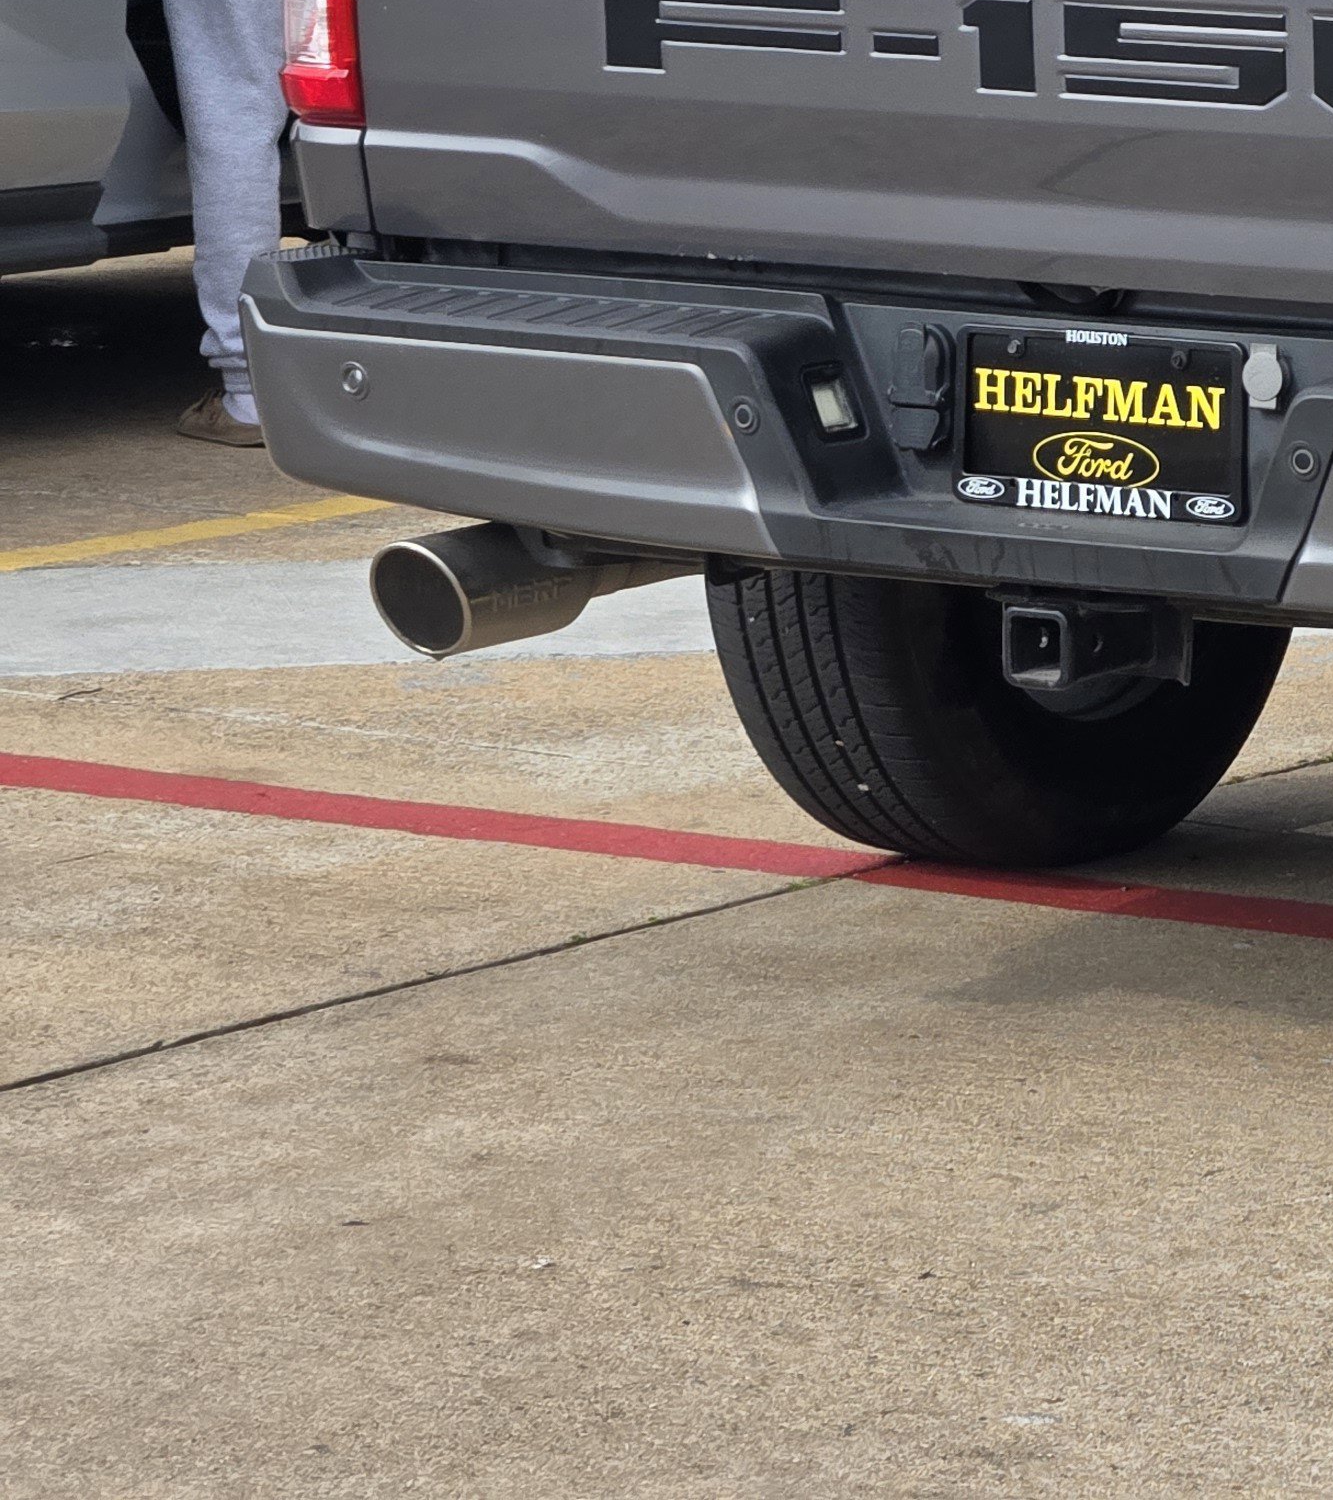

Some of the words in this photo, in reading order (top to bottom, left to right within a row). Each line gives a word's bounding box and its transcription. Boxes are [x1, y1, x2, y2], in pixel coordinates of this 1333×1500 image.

[1066, 329, 1128, 347] HOUSTON
[973, 367, 1226, 430] HELFMAN
[1057, 436, 1135, 481] Ford
[1016, 477, 1173, 519] HELFMAN
